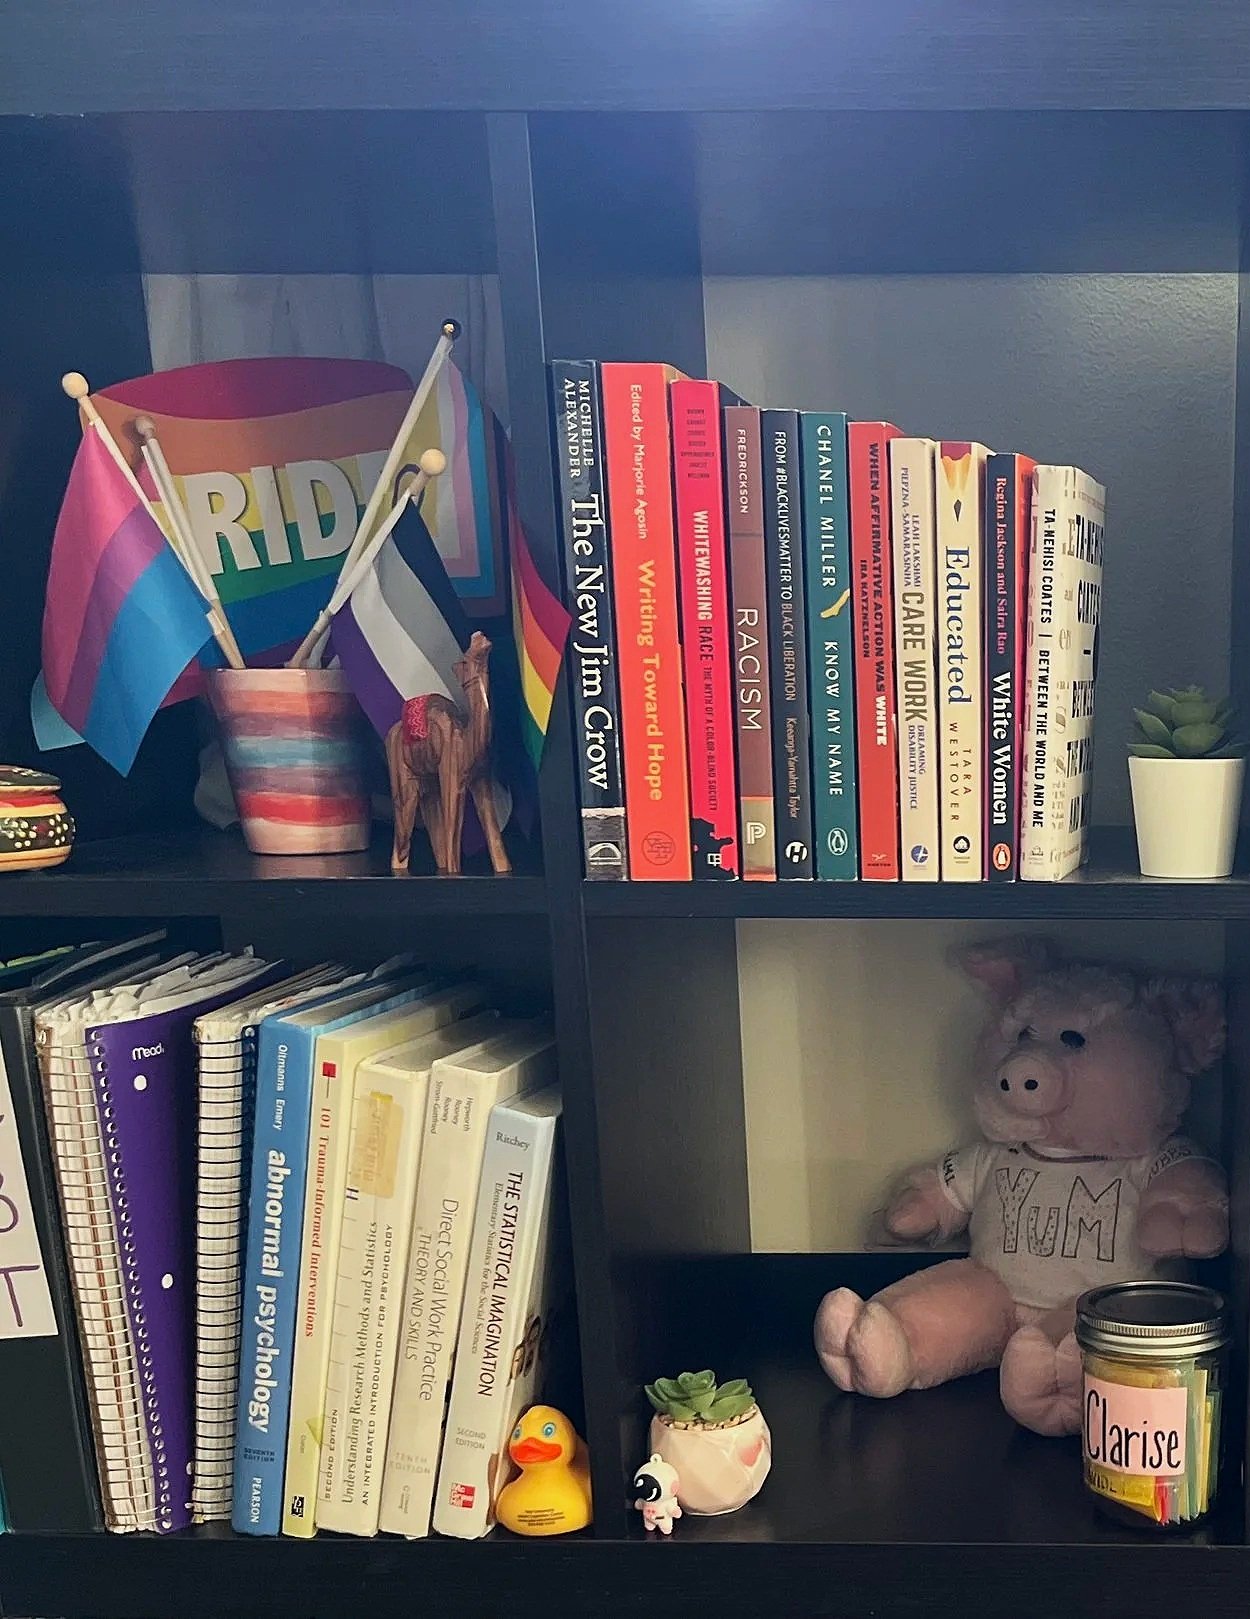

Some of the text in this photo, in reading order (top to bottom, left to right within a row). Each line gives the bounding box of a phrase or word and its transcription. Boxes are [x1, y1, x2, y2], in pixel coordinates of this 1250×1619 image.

[564, 378, 582, 479] ALEXANDER
[579, 379, 595, 467] MICHELLE
[737, 429, 749, 514] FREDRICKSON
[775, 431, 797, 701] FROM #BLACKLIVESMATTER TO BLACK LIBERATION
[817, 425, 837, 589] CHANEL MILLER
[993, 477, 1009, 655] Regina Jackson and Saira Rao
[571, 493, 613, 790] The New Jim Crow
[737, 609, 762, 730] RACISM
[869, 443, 888, 747] WHEN AFFIRMATIVE ACTION WAS WHITE
[901, 592, 929, 723] CARE WORK
[944, 546, 973, 705] Educated
[637, 560, 666, 801] Writing Toward Hope
[824, 641, 844, 797] KNOW MY NAME
[992, 672, 1013, 825] White Women
[1032, 650, 1051, 829] BETWEEN THE WORLD AND ME
[949, 722, 961, 822] WESTOVER
[962, 749, 973, 796] TARA
[273, 1045, 289, 1131] Oltmanns Emery
[249, 1150, 292, 1433] abnormal psychology
[304, 1107, 332, 1338] 101 Trauma-Informed Interventions
[341, 1222, 379, 1504] Understanding Research Methods and Statistics
[361, 1225, 393, 1506] AN INTEGRATED INTRODUCTION FOR PSYCHOLOGY
[1087, 1389, 1181, 1469] Clarise
[249, 1476, 263, 1524] PEARSON
[325, 1409, 339, 1500] SECOND EDITION
